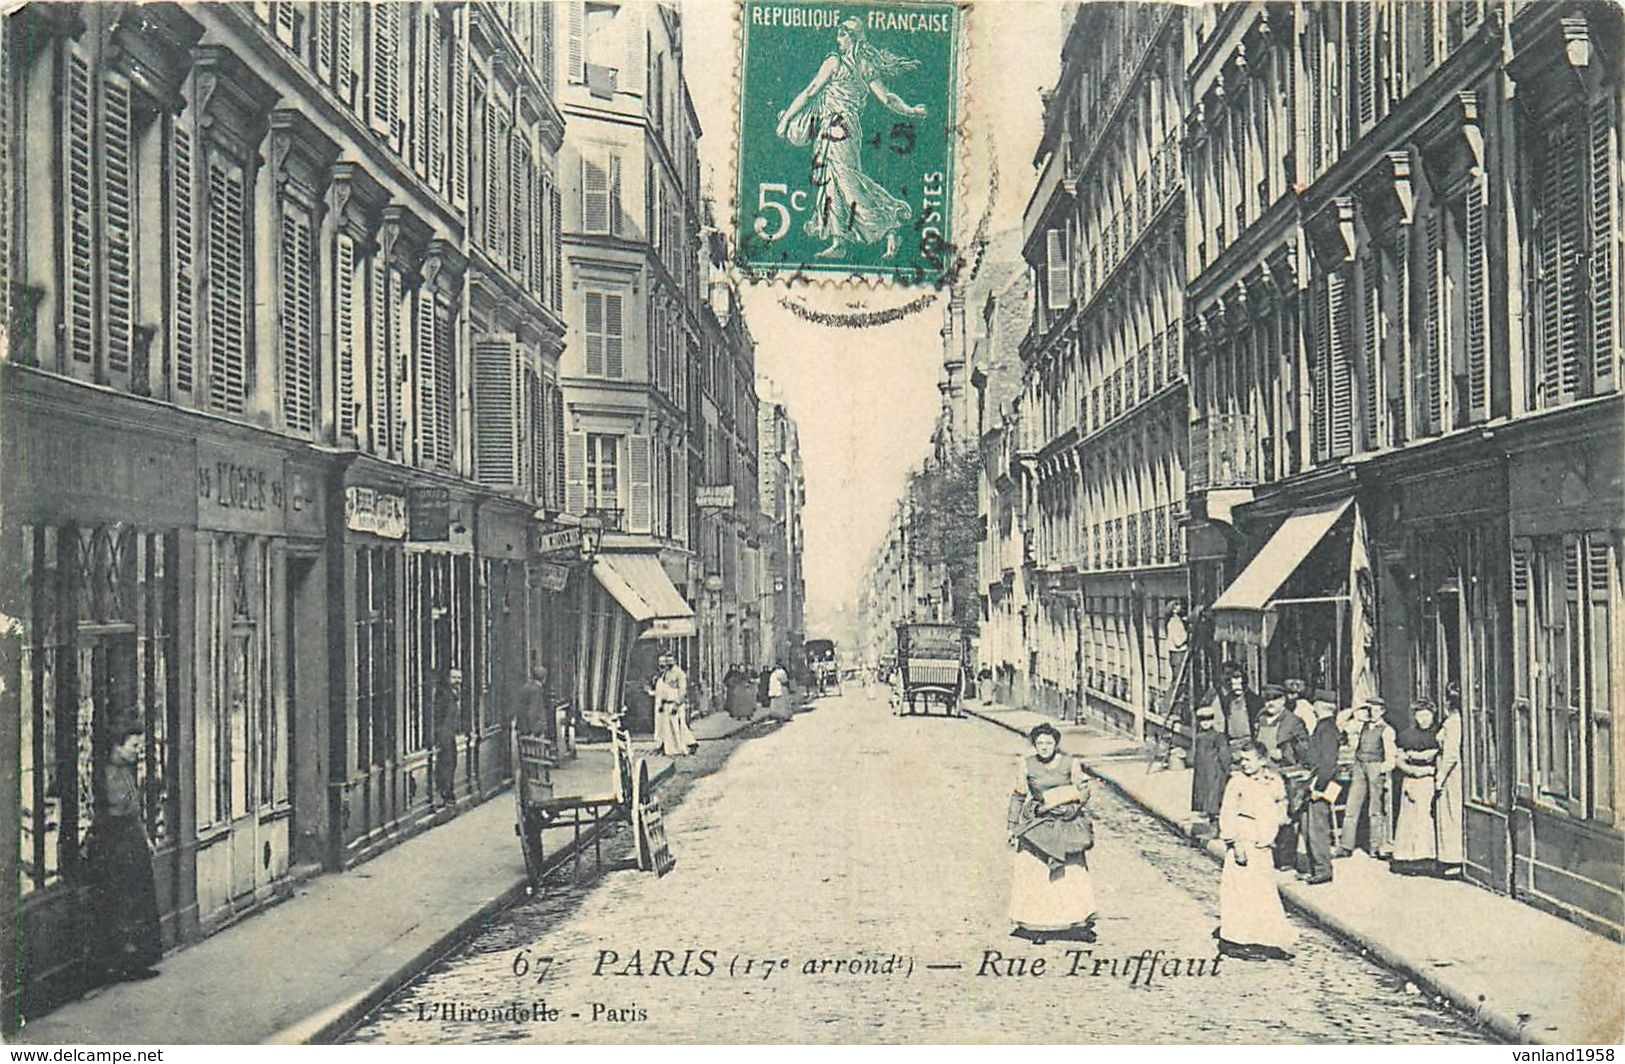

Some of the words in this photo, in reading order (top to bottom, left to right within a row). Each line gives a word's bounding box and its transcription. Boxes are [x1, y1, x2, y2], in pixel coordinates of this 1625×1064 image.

[752, 6, 840, 31] REPUBLIQUE
[867, 11, 949, 34] FRANÇAISE
[920, 170, 943, 260] POSTES
